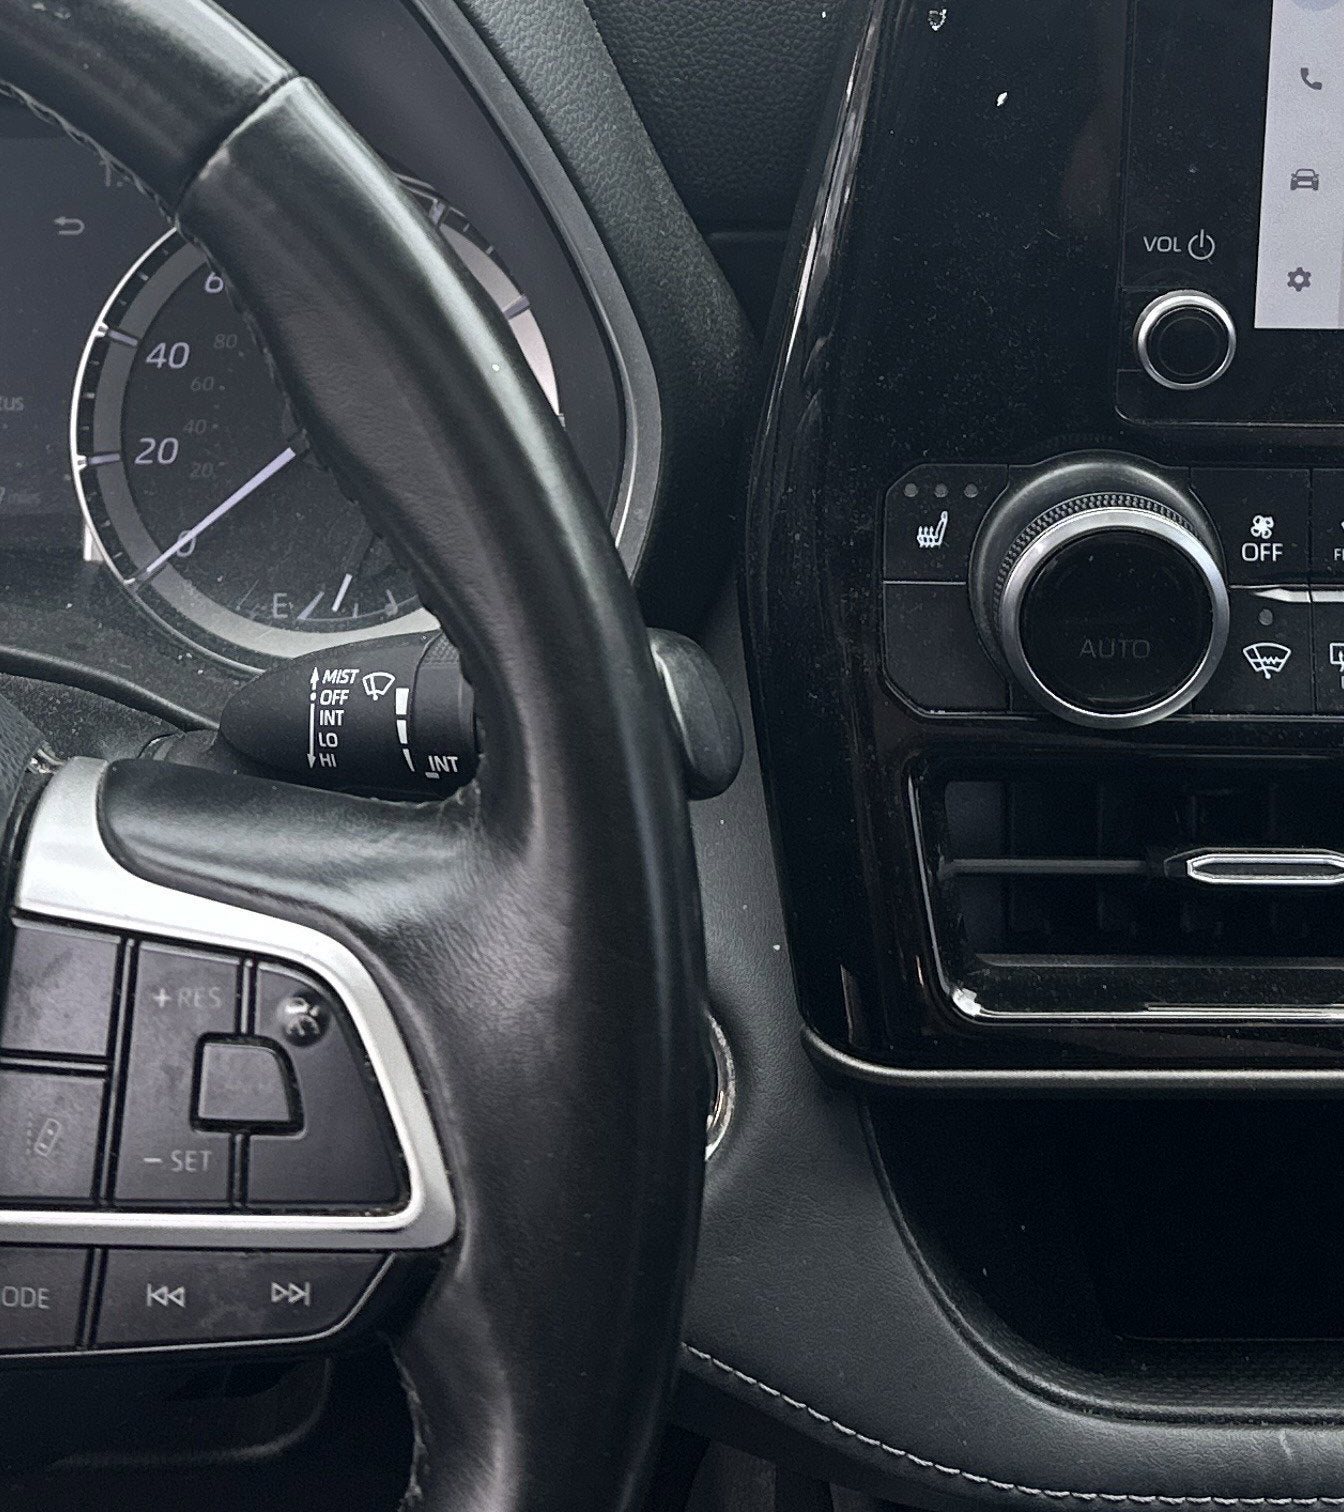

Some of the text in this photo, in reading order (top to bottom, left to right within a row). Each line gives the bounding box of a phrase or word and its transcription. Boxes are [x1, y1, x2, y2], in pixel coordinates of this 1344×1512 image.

[1143, 235, 1182, 253] VOL
[213, 333, 238, 351] 80
[146, 341, 191, 369] 40
[190, 375, 215, 392] 60
[183, 419, 208, 436] 40
[135, 437, 180, 465] 20
[189, 462, 214, 479] 20
[174, 529, 197, 559] 0
[1241, 542, 1284, 563] OFF
[272, 592, 288, 619] E
[1077, 638, 1152, 659] AUTO
[321, 668, 360, 685] MIST
[319, 688, 350, 706] OFF
[318, 709, 345, 726] INT
[318, 731, 339, 749] LO
[318, 752, 338, 768] HI
[427, 754, 459, 773] INT
[170, 1149, 213, 1173] SET
